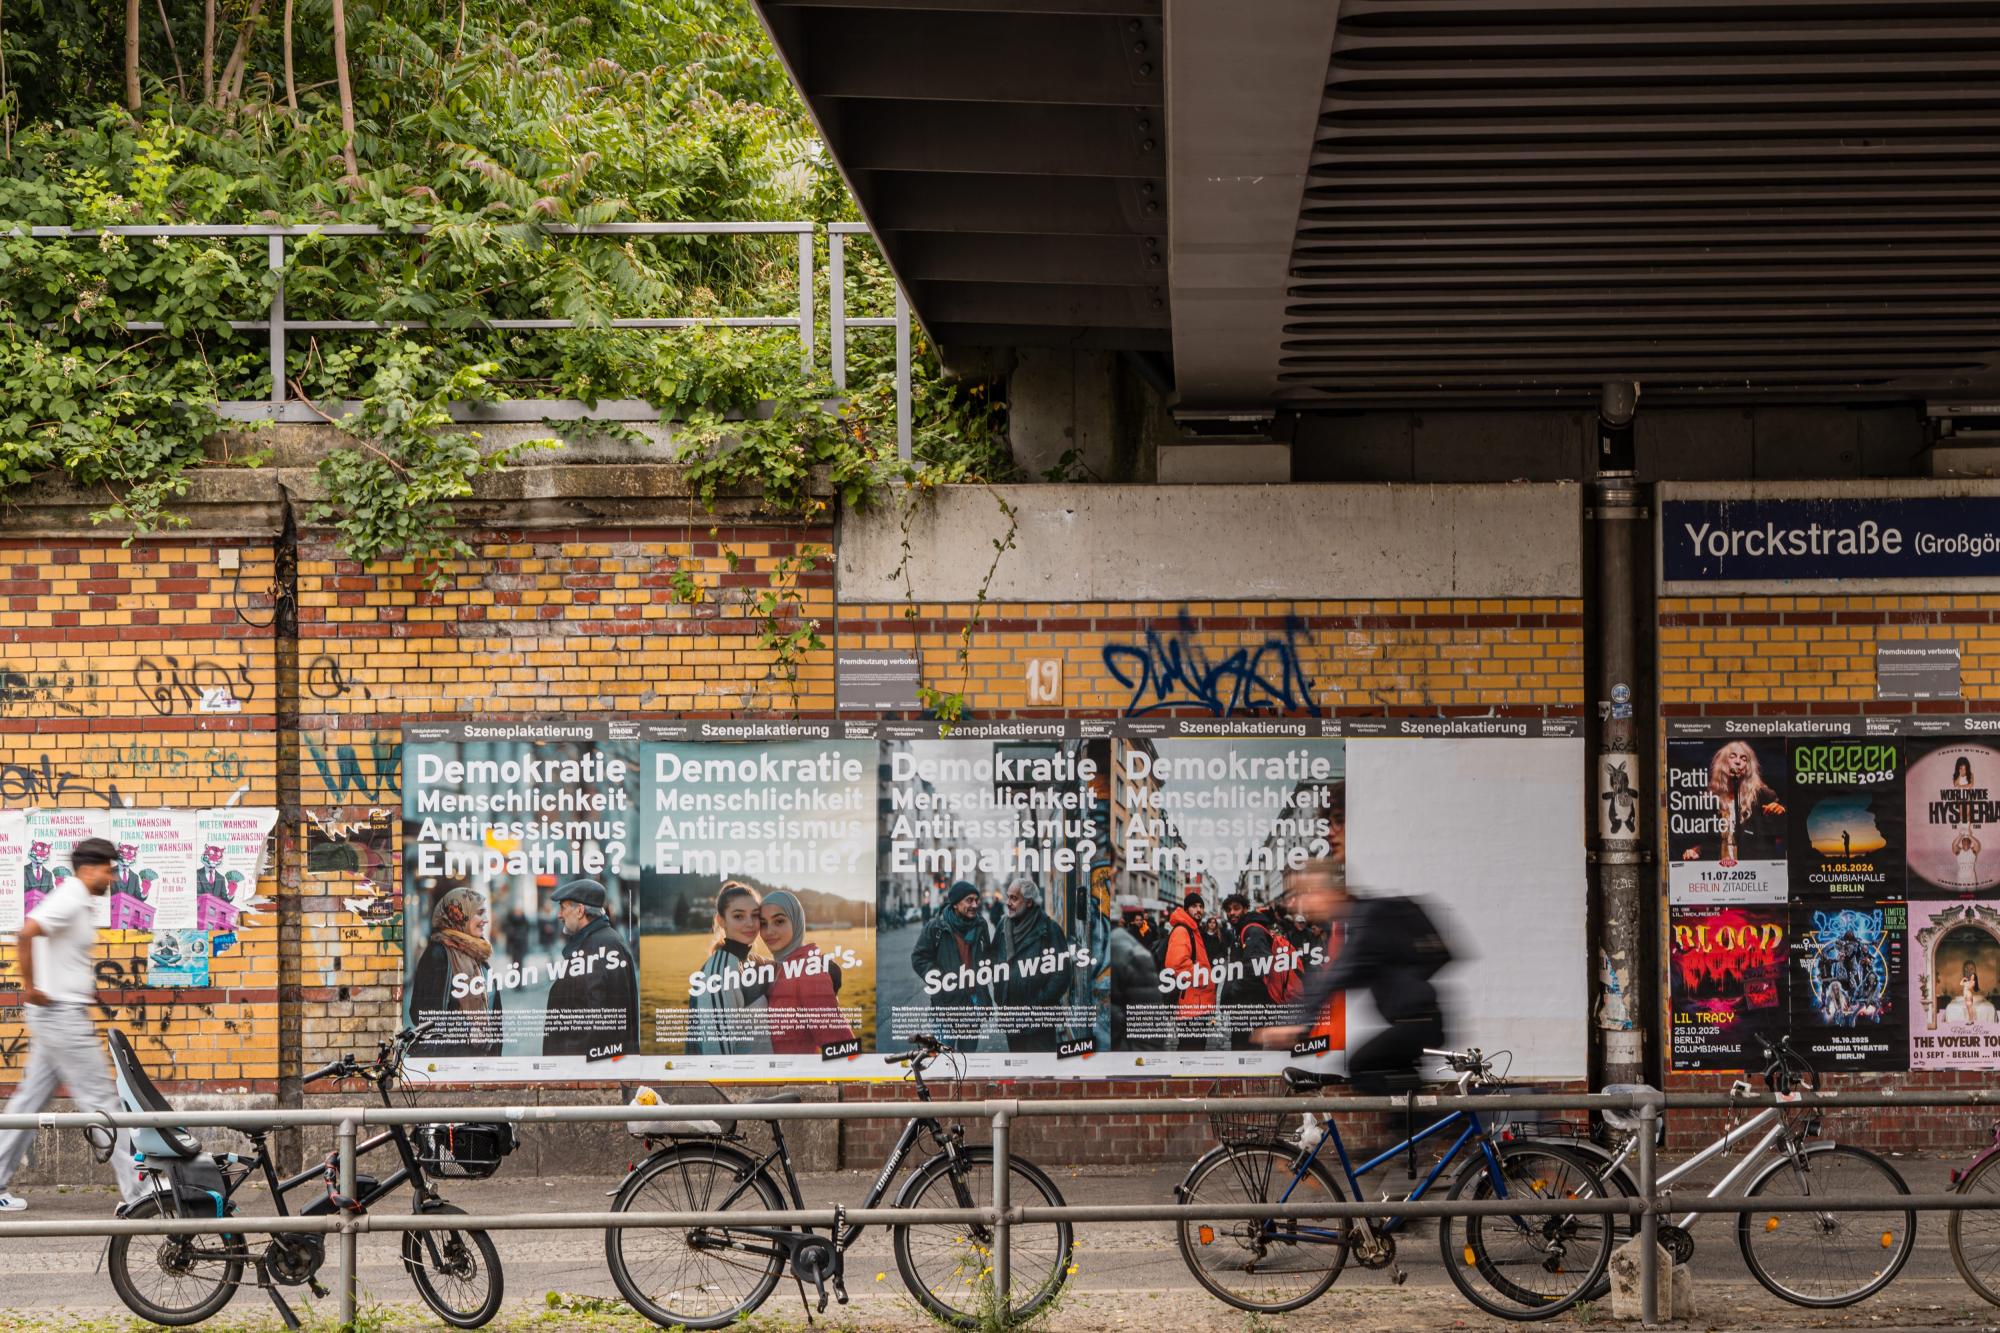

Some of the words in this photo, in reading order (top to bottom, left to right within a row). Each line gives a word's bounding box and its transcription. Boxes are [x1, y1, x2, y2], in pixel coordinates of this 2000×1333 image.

[1685, 520, 1902, 557] Yorckstraße
[840, 658, 888, 666] Fremdnutzung
[1026, 659, 1058, 701] 19
[464, 725, 593, 740] Szeneplakatierung
[701, 723, 830, 739] Szeneplakatierung
[1179, 720, 1306, 736] Szeneplakatierung
[1400, 721, 1527, 736] Szeneplakatierung
[1725, 719, 1851, 734] Szeneplakatierung
[417, 753, 626, 783] Demokratie
[656, 752, 862, 783] Demokratie
[891, 751, 1097, 782] Demokratie
[1126, 750, 1330, 780] Demokratie
[1670, 768, 1708, 787] Patti
[1796, 772, 1857, 784] OFFLINE
[1858, 770, 1894, 784] 2026
[417, 789, 626, 812] Menschlichkeit
[656, 789, 863, 812] Menschlichkeit
[891, 786, 1098, 810] Menschlichkeit
[1126, 785, 1331, 810] Menschlichkeit
[1670, 790, 1720, 811] Smith
[1941, 789, 1988, 800] WORLDWIDE
[26, 816, 85, 825] MIETENWAHNSINN
[112, 818, 171, 828] MIETENWAHNSINN
[199, 820, 257, 829] MIETENWAHNSINN
[655, 816, 862, 840] Antirassismus
[891, 814, 1096, 839] Antirassismus
[1126, 813, 1330, 837] Antirassismus
[34, 828, 92, 837] FINANZWAHNSINN
[120, 831, 179, 840] FINANZWAHNSINN
[417, 817, 626, 841] Antirassismus
[140, 843, 192, 852] OBBYWAHNSINN
[417, 841, 626, 882] Empathie?
[656, 841, 860, 882] Empathie?
[891, 839, 1097, 880] Empathie?
[1701, 871, 1756, 880] 11.07.2025
[1821, 864, 1873, 872] 11.05.2026
[1809, 874, 1885, 882] COLUMBIAHALLE
[1689, 883, 1720, 892] BERLIN
[1723, 882, 1768, 892] ZITADELLE
[1830, 884, 1864, 892] BERLIN
[1673, 924, 1783, 952] BLOOD
[451, 962, 538, 999] Schön
[546, 946, 627, 978] wär's.
[688, 961, 775, 997] Schön
[783, 945, 863, 978] wär's.
[923, 959, 1011, 996] Schön
[1018, 943, 1098, 976] wär's.
[1158, 957, 1246, 993] Schön
[1253, 942, 1330, 976] wär's.
[1675, 1013, 1692, 1023] LIL
[1696, 1013, 1734, 1023] TRACY
[1060, 1039, 1093, 1054] CLAIM
[1294, 1037, 1328, 1052] CLAIM
[1675, 1036, 1705, 1044] BERLIN
[1913, 1037, 1934, 1047] THE
[1938, 1036, 1980, 1047] VOYEUR
[589, 1043, 623, 1059] CLAIM
[825, 1042, 858, 1057] CLAIM
[1675, 1045, 1741, 1053] COLUMBIAHALLE
